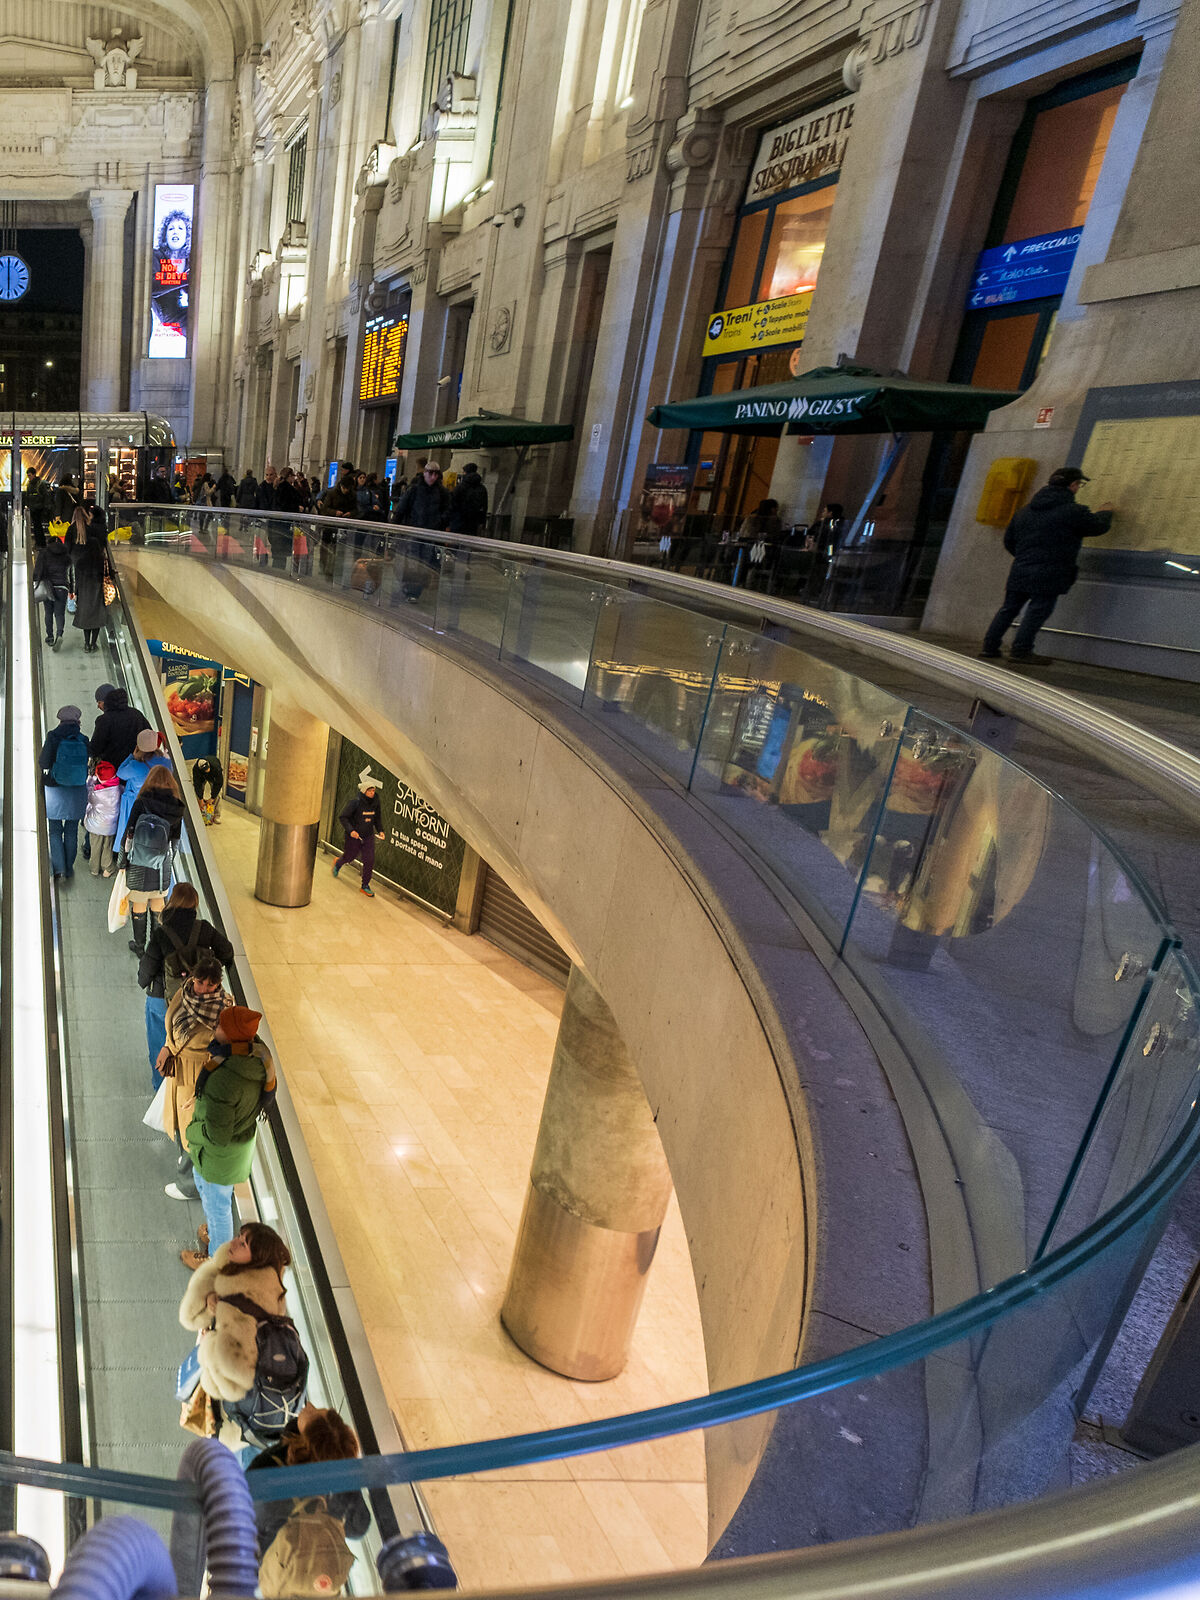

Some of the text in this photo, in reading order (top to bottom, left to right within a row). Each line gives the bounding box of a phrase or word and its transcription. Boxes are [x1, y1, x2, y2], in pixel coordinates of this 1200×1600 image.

[155, 272, 187, 280] SI DEVE
[161, 264, 178, 272] NON
[726, 308, 754, 327] Treni
[723, 328, 743, 339] Trains
[735, 400, 788, 419] PANINO
[21, 435, 57, 445] SECRET
[394, 800, 450, 838] DINTORNI
[391, 827, 428, 852] La tua spesa
[421, 830, 447, 849] CONAD
[395, 839, 417, 856] portata
[417, 850, 425, 860] di
[425, 855, 443, 870] mano
